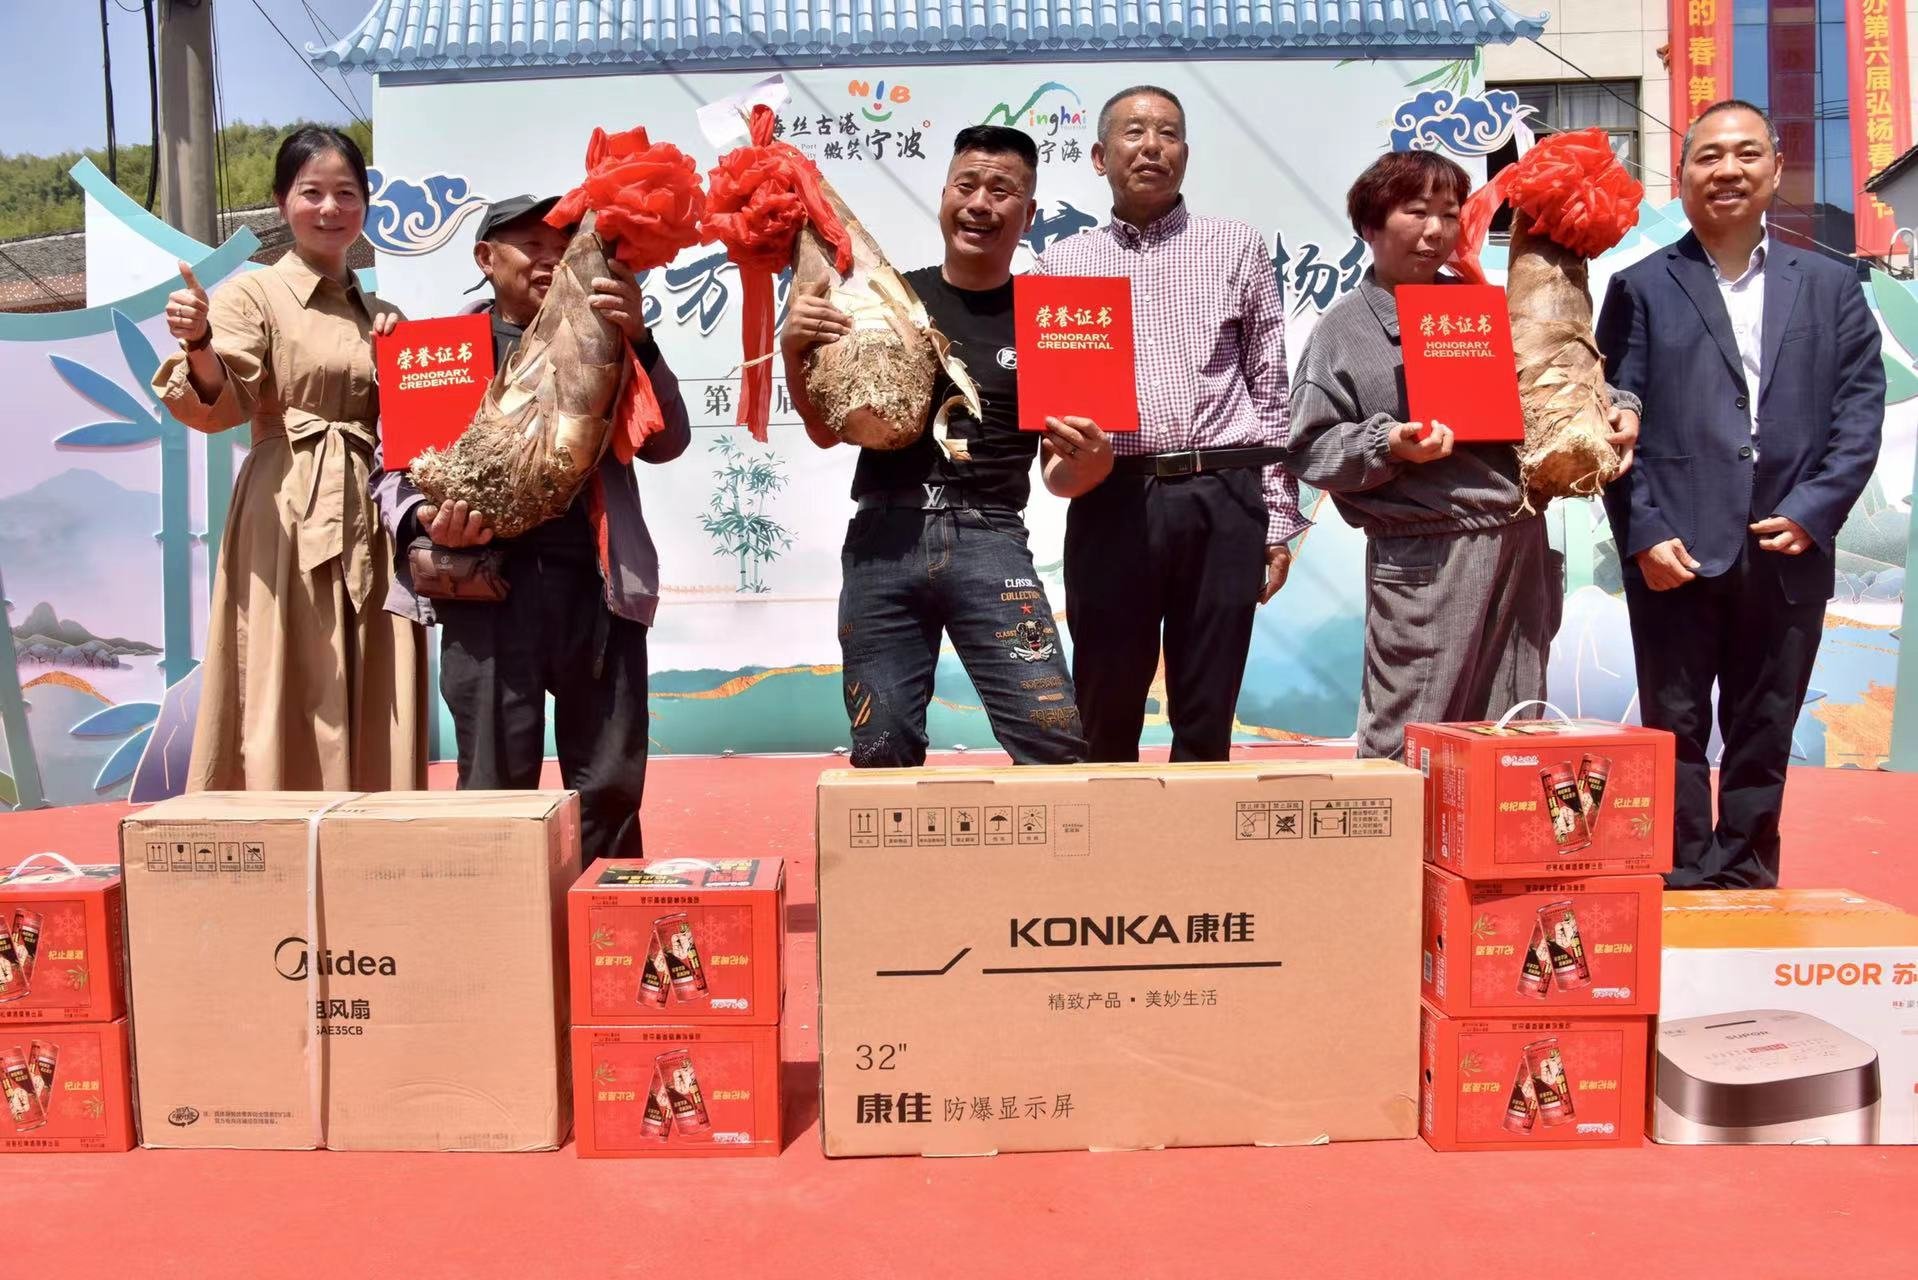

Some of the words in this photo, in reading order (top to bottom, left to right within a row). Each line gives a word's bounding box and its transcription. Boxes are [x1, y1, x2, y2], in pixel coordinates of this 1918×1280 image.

[1037, 139, 1083, 163] 宁海
[1035, 305, 1113, 329] 荣誉证书
[1419, 313, 1493, 338] 荣誉证书
[1037, 341, 1114, 350] CREDENTIAL
[1041, 333, 1109, 341] HONORARY
[1426, 341, 1490, 349] HONORARY
[397, 342, 473, 371] 荣誉证书
[1423, 349, 1496, 359] CREDENTIAL
[399, 377, 475, 391] CREDENTIAL
[402, 367, 470, 382] HONORARY
[703, 384, 796, 416] 第届
[1010, 915, 1177, 948] KONKA
[1186, 911, 1255, 944] 康佳
[1775, 963, 1882, 986] SUPOR
[857, 1093, 932, 1124] 康佳
[944, 1093, 1075, 1121] 防爆显示屏
